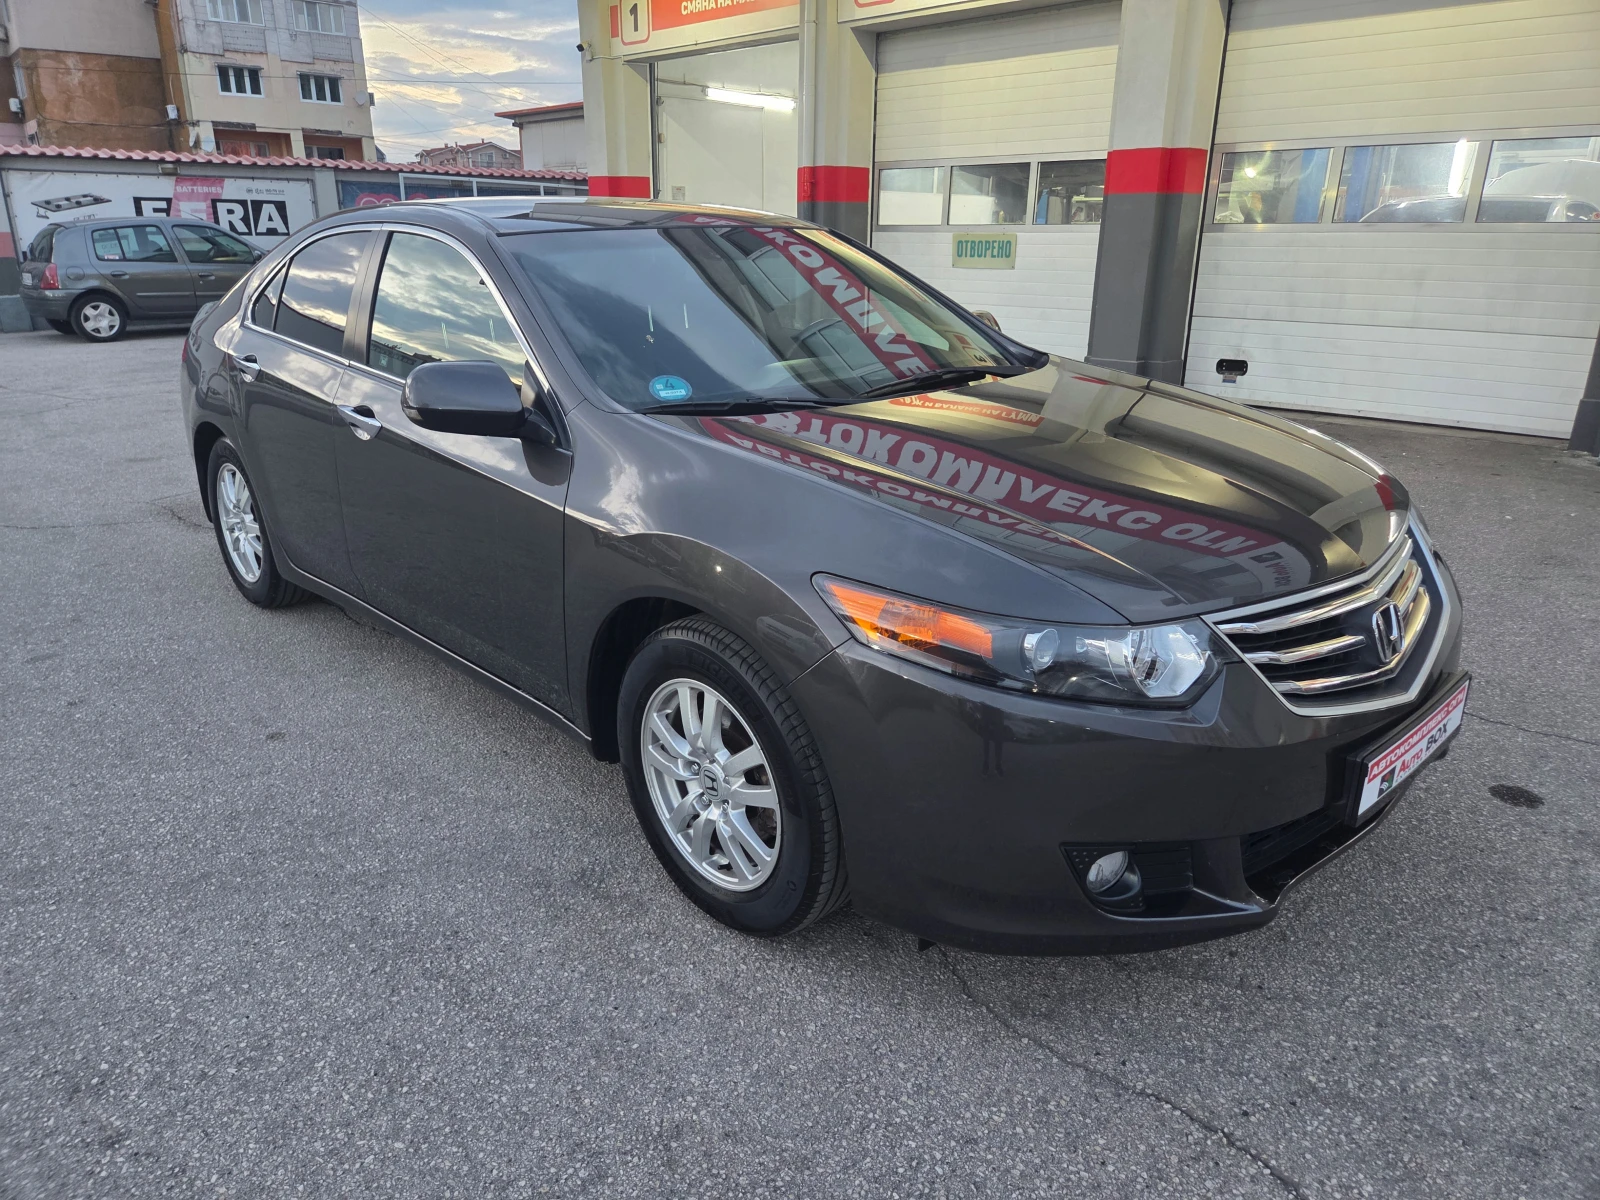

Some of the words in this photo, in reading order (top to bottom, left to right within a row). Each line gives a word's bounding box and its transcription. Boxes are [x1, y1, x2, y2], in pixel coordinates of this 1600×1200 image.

[628, 2, 640, 33] 1
[681, 0, 716, 15] СМЯНА
[175, 185, 223, 194] BATTERIES
[956, 239, 1012, 259] ОТВОРЕНО
[1425, 720, 1449, 752] BOX
